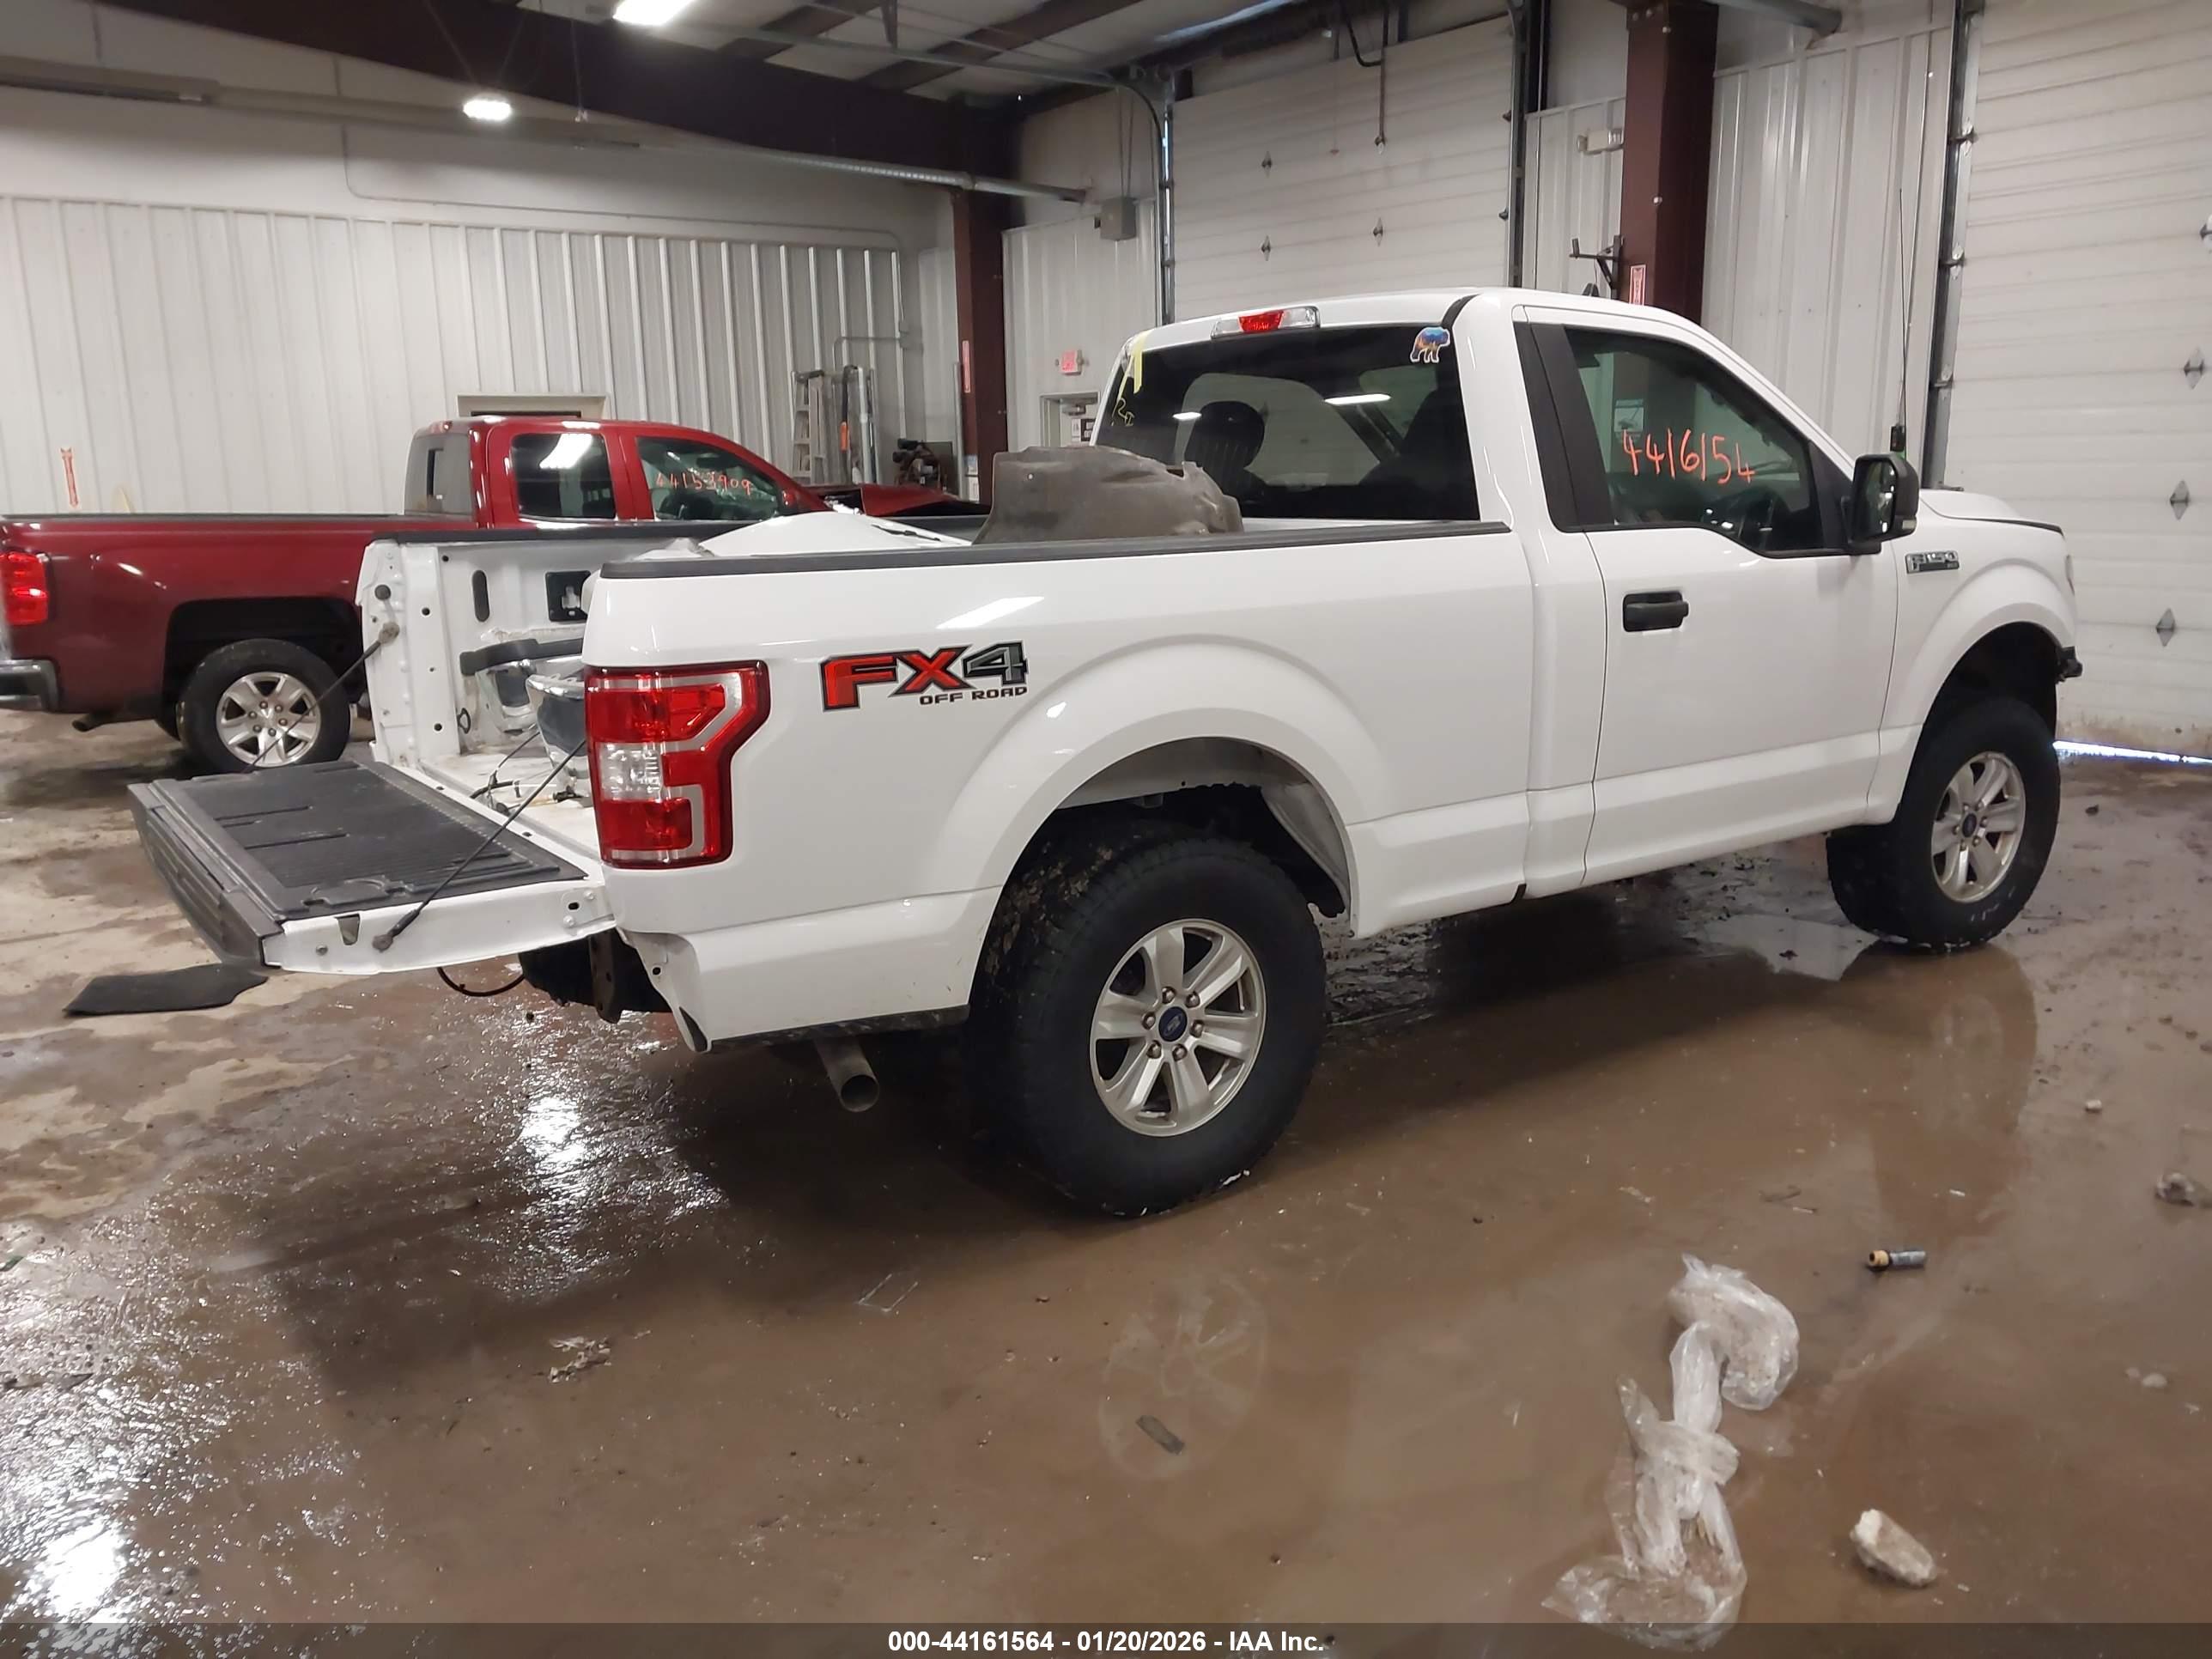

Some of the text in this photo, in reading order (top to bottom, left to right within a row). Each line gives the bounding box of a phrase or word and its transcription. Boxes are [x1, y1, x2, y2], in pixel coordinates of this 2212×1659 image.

[819, 641, 1029, 711] FX4
[920, 686, 1028, 706] OFF ROAD
